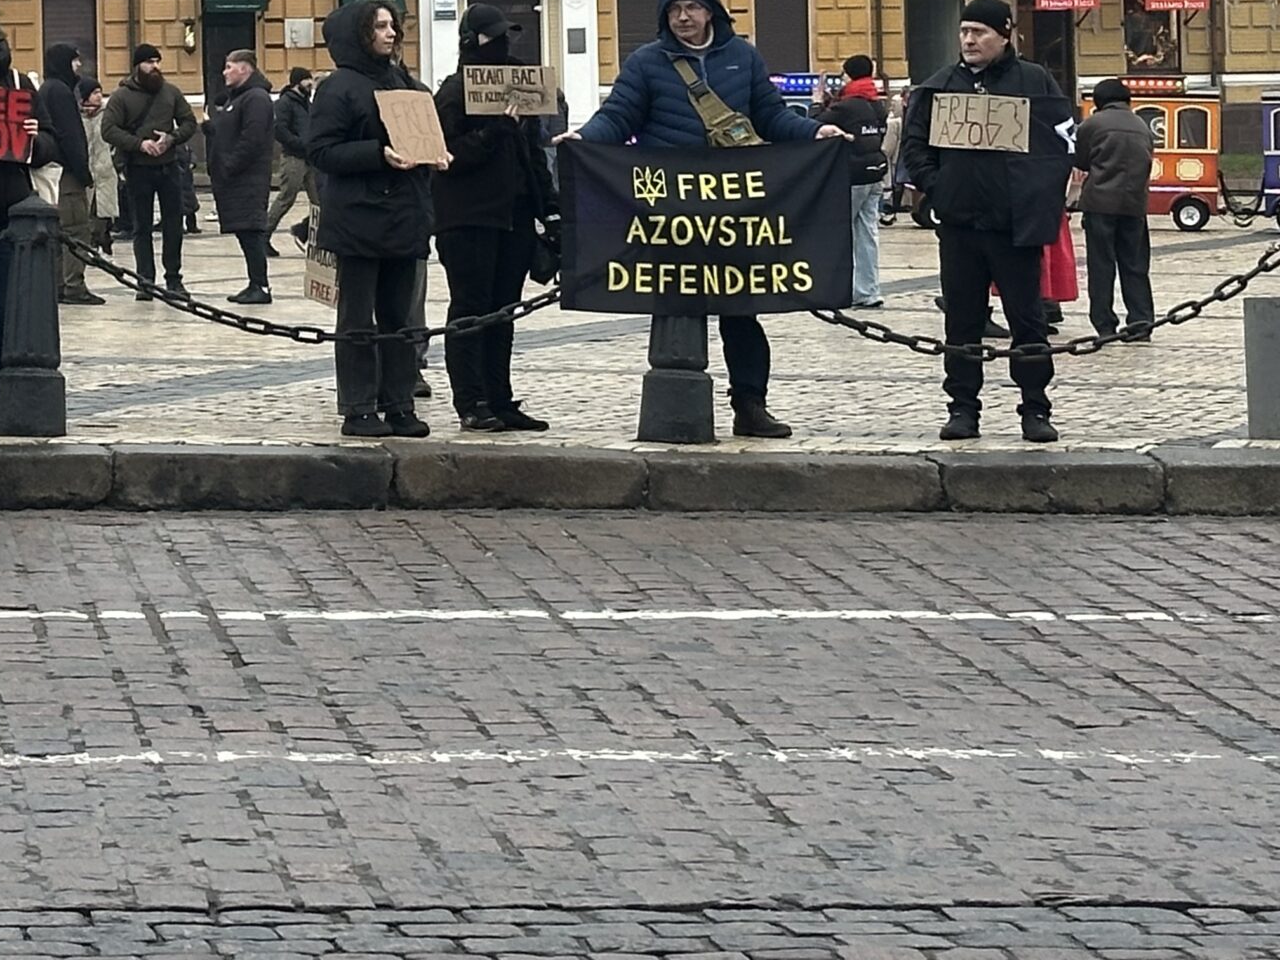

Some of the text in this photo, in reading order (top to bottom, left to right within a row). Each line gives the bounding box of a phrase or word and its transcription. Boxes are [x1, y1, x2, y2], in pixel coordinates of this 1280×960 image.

[466, 68, 504, 86] ЧЕКАЮ
[390, 99, 439, 136] FREE
[937, 96, 1000, 125] FREE
[937, 121, 1003, 146] AZOV
[677, 171, 766, 200] FREE
[626, 215, 793, 247] AZOVSTAL
[310, 279, 331, 301] FREE
[608, 260, 814, 295] DEFENDERS
